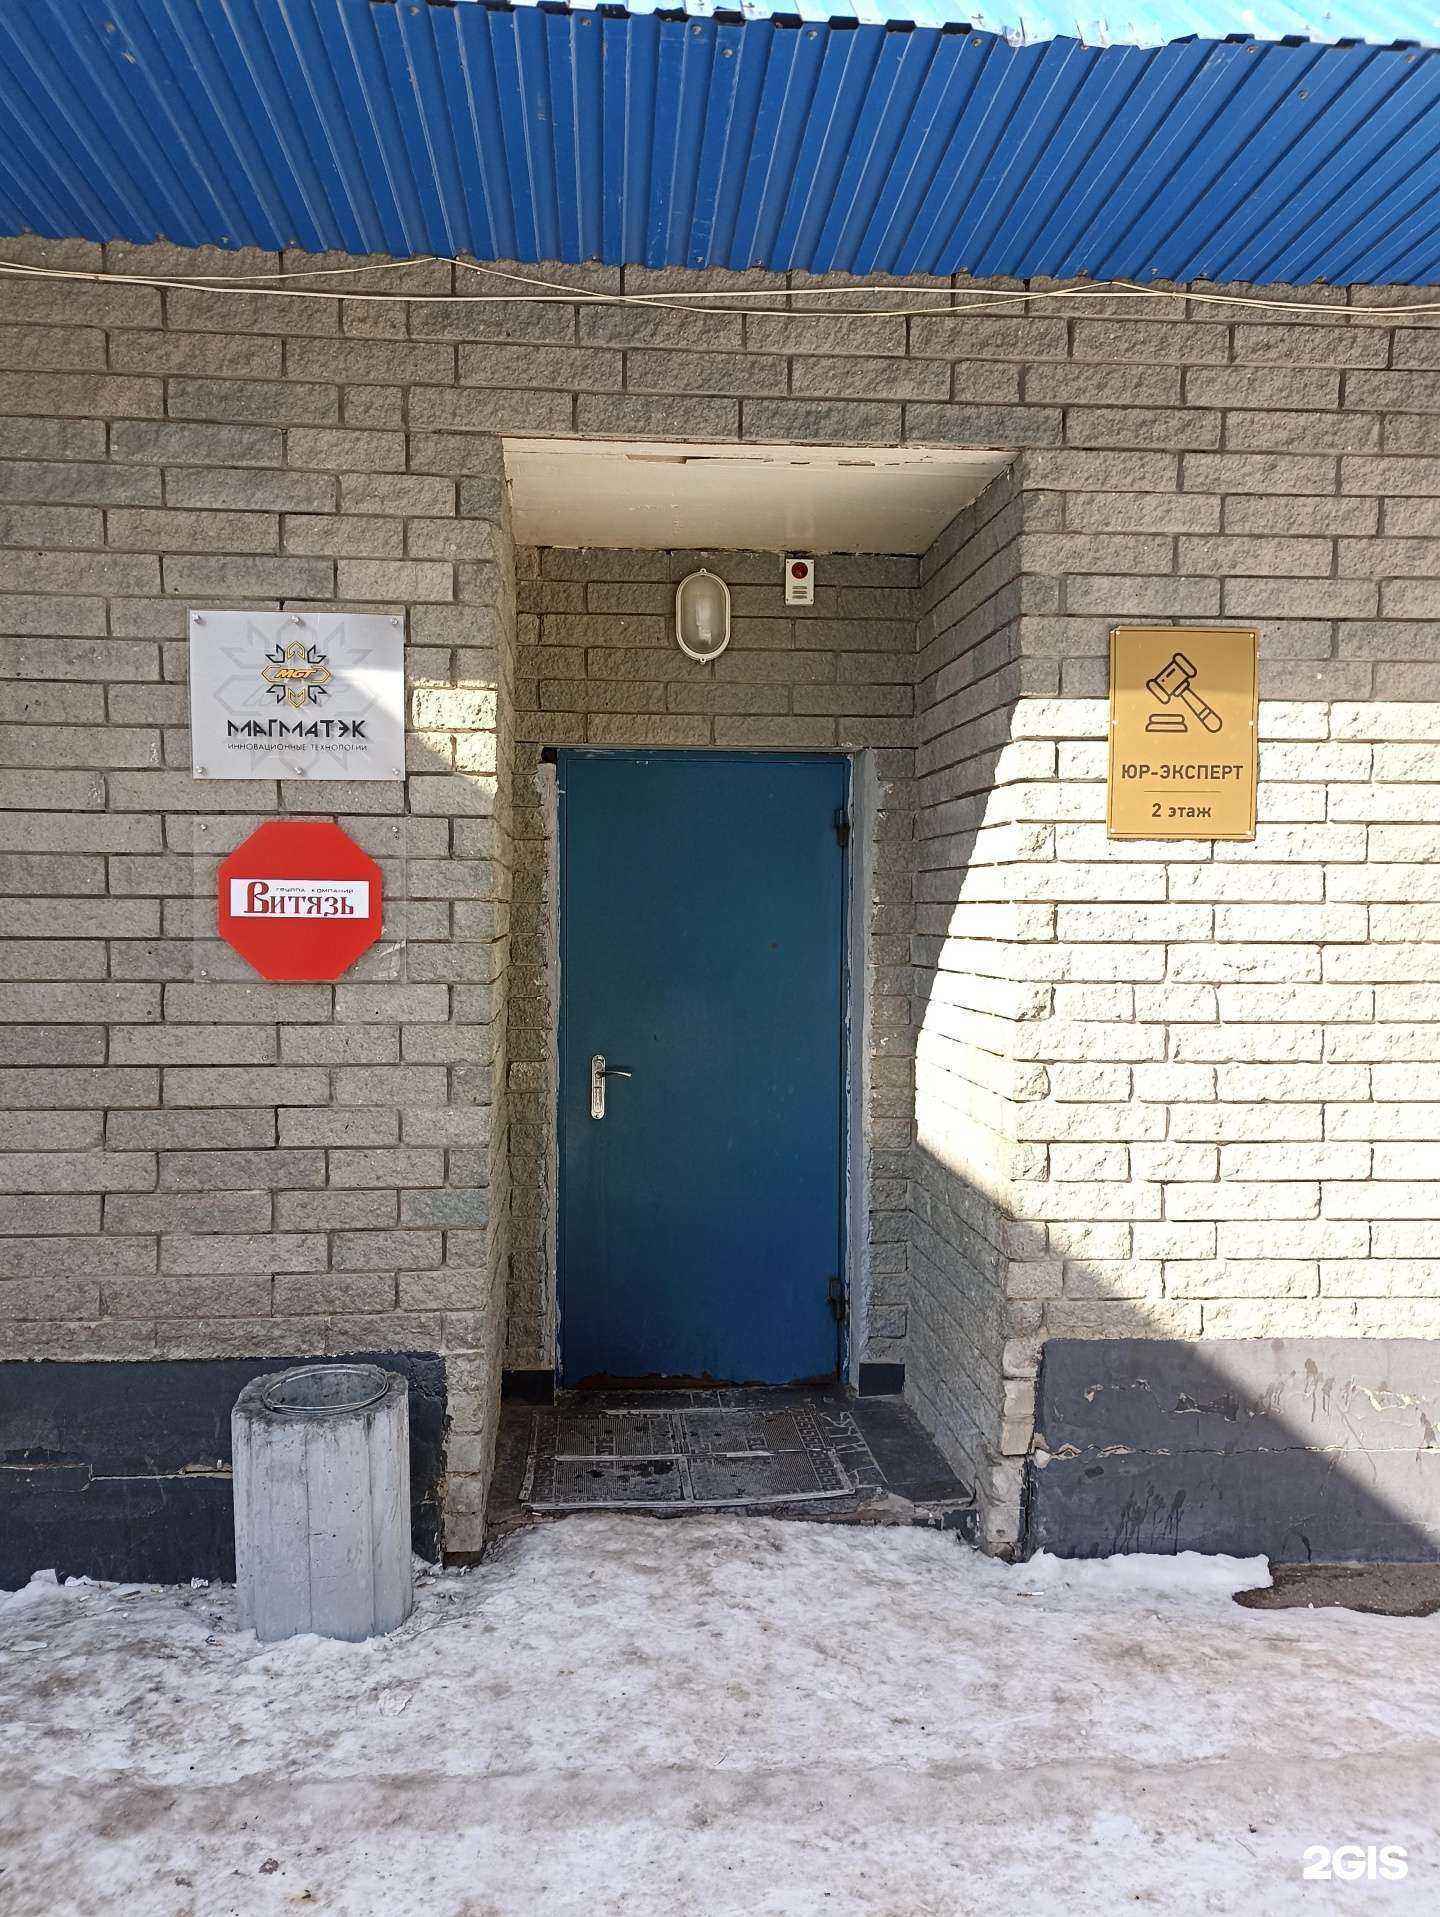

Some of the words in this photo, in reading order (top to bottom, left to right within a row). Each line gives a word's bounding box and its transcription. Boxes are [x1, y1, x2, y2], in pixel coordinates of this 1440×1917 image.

[274, 668, 318, 679] MGT
[227, 718, 366, 738] МАГМАТЭК
[227, 743, 306, 752] ИННОВАЦИОННЫЕ
[310, 743, 368, 752] ТЕХНОЛОГИИ
[1121, 763, 1244, 780] ЮР-ЭКСПЕРТ
[1151, 803, 1162, 818] 2
[1168, 806, 1212, 818] этаж
